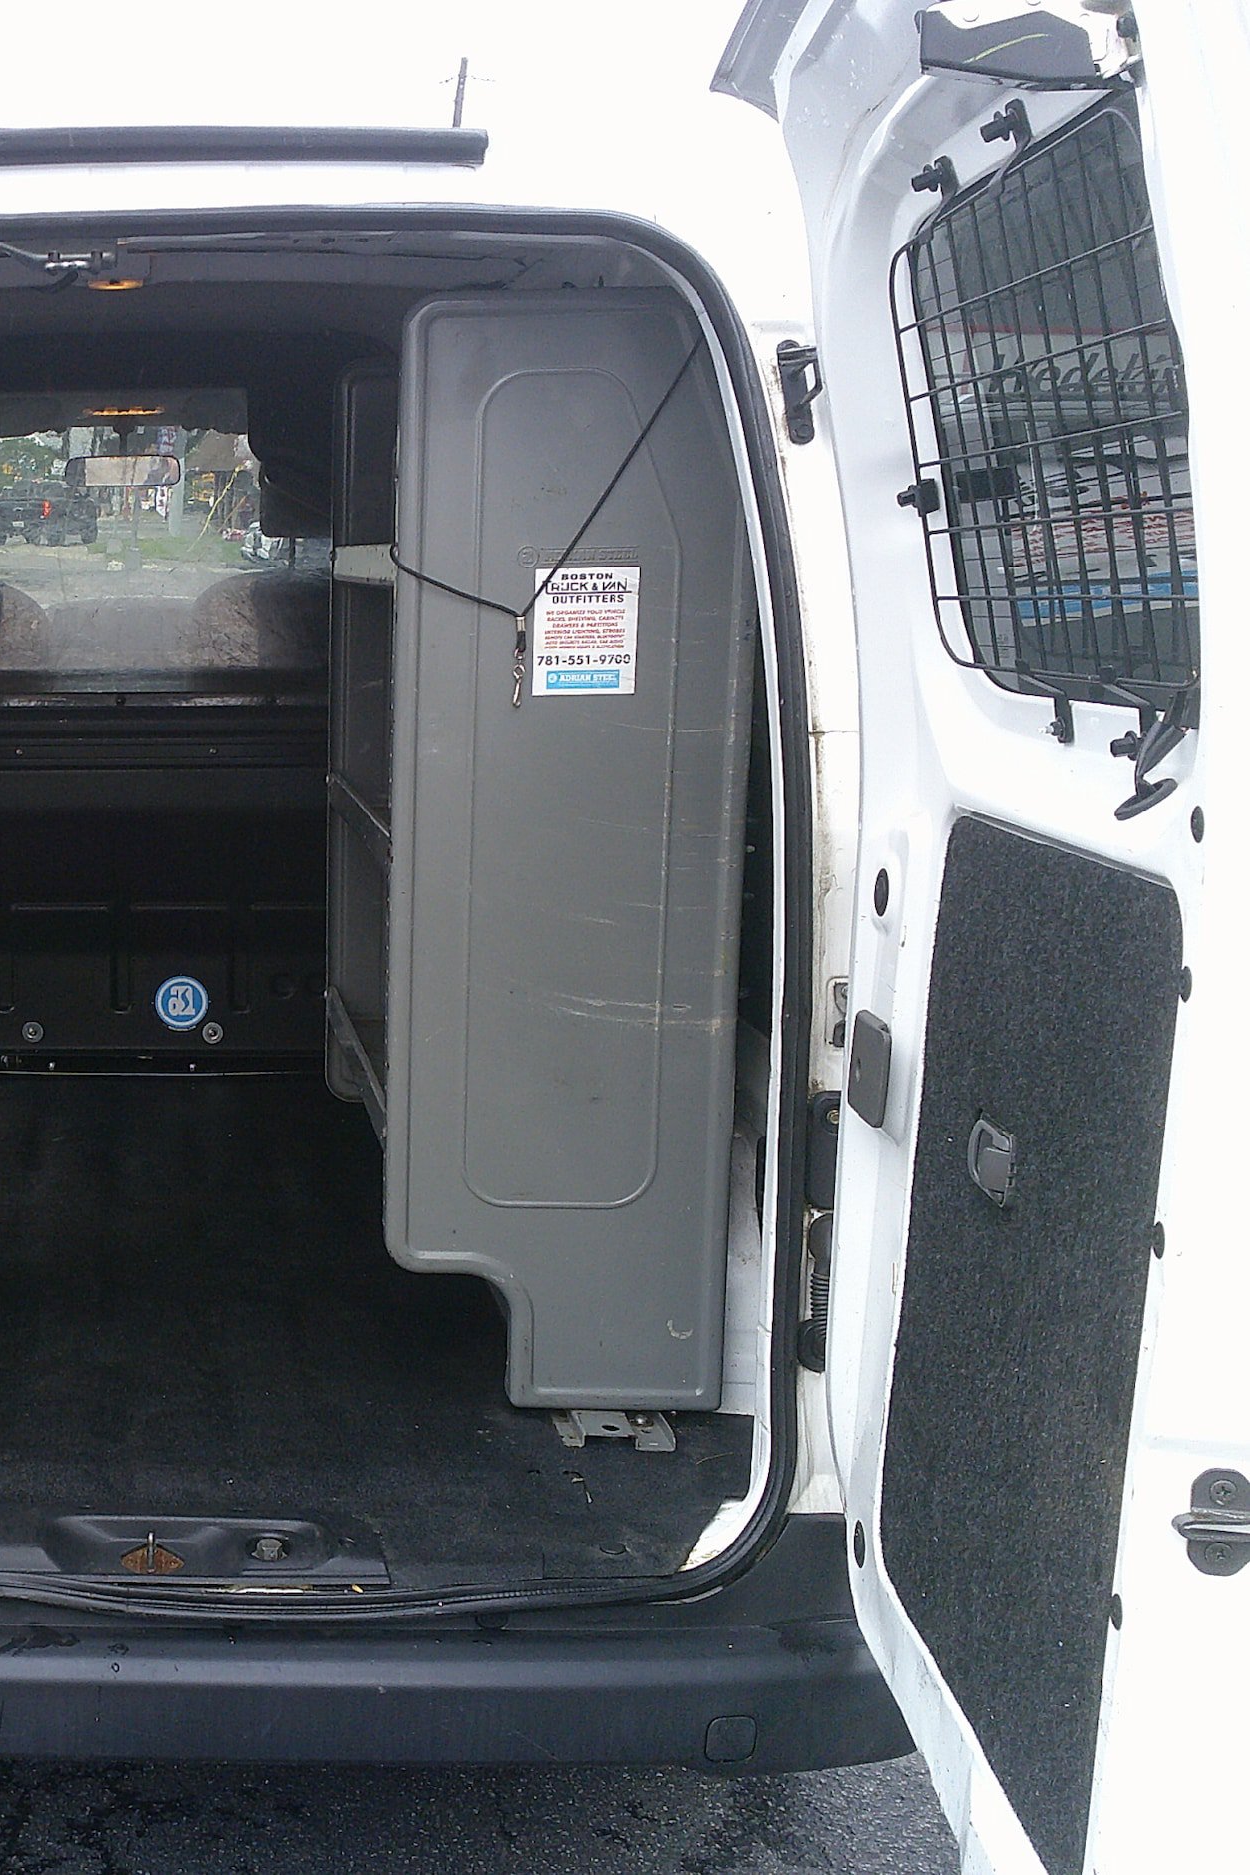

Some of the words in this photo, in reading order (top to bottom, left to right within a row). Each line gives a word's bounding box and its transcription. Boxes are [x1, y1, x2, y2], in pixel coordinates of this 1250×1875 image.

[561, 572, 613, 580] BOSTON
[591, 582, 599, 591] &
[602, 579, 628, 591] VAN
[552, 594, 624, 604] OUTFITTERS
